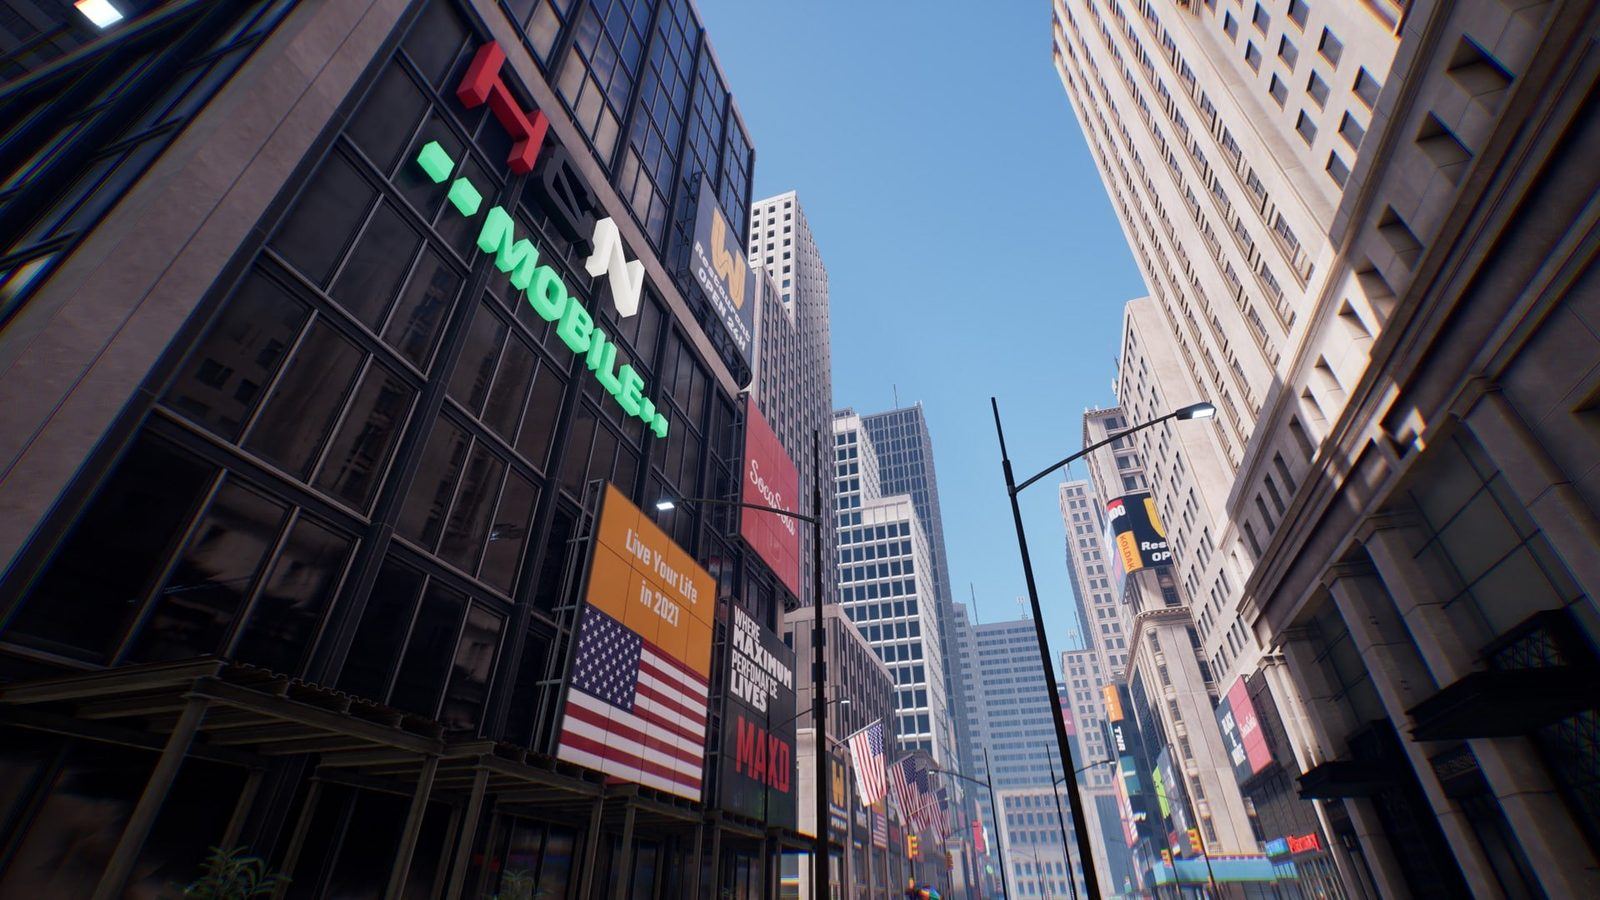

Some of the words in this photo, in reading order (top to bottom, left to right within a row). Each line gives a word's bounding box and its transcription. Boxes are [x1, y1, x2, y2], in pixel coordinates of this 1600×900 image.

[695, 241, 751, 343] Restaurant
[698, 267, 726, 318] OPEN
[726, 315, 746, 352] 24H
[625, 528, 651, 565] Live
[654, 550, 678, 587] Your
[680, 574, 698, 604] Life
[640, 580, 652, 608] in
[653, 592, 680, 627] 2021
[734, 605, 760, 644] WHERE
[731, 668, 767, 712] LIVES
[733, 624, 792, 690] MAXIMUM
